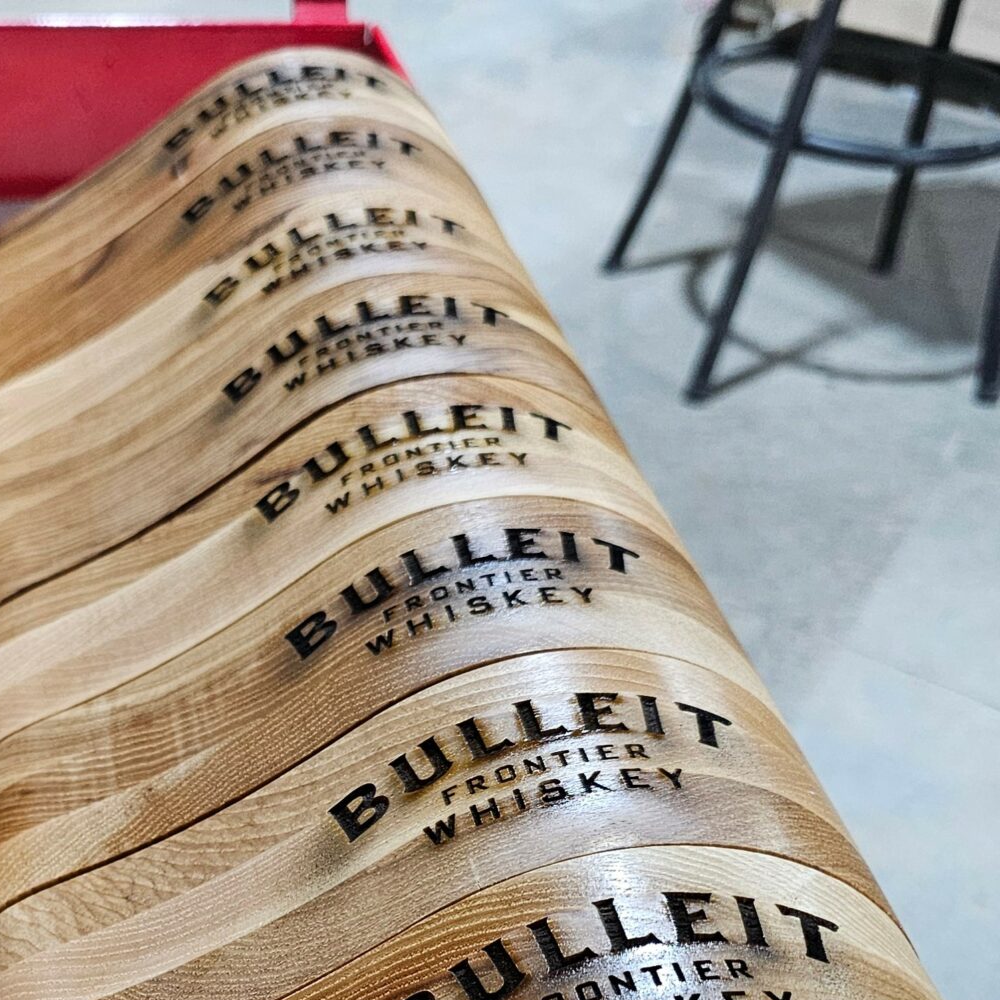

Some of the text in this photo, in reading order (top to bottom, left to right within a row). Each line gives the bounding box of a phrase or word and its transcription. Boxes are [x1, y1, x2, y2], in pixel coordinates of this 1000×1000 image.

[181, 131, 423, 225] BULLEIT
[202, 208, 466, 305] BULLEIT
[222, 295, 510, 401] BULLEIT
[283, 334, 466, 391] WHISKEY
[298, 321, 444, 366] FRONTIER
[254, 405, 572, 523] BULLEIT
[324, 451, 527, 516] WHISKEY
[341, 437, 501, 487] FRONTIER
[284, 528, 640, 660] BULLEIT
[365, 587, 593, 656] WHISKEY
[383, 567, 564, 624] FRONTIER
[327, 692, 732, 843] BULLEIT
[442, 743, 650, 806] FRONTIER
[423, 767, 683, 846] WHISKEY
